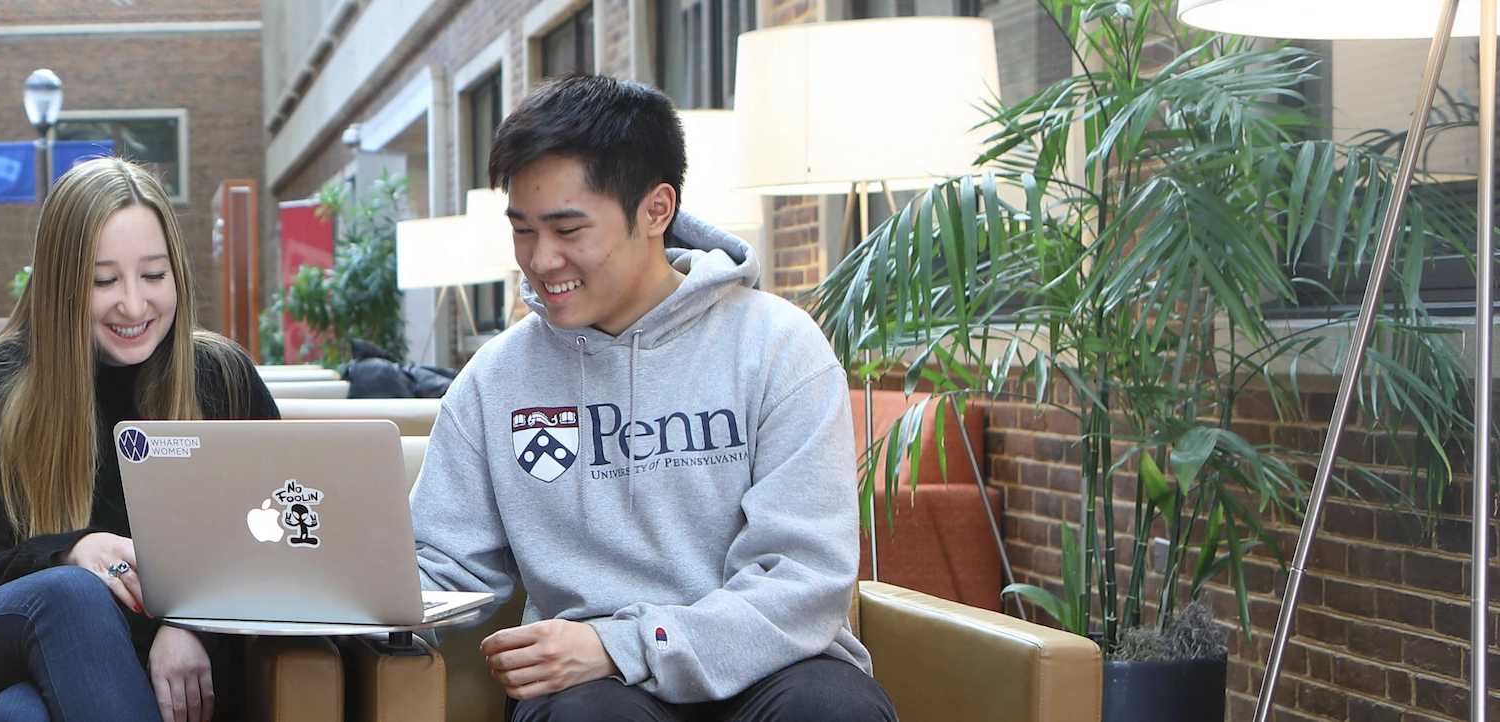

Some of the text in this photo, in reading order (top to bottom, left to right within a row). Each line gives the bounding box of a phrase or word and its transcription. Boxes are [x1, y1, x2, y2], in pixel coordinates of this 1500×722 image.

[586, 403, 746, 466] Penn
[150, 438, 198, 447] WHARTON
[152, 447, 189, 455] WOMEN
[590, 464, 647, 480] UNIVERSTY
[649, 458, 661, 471] of
